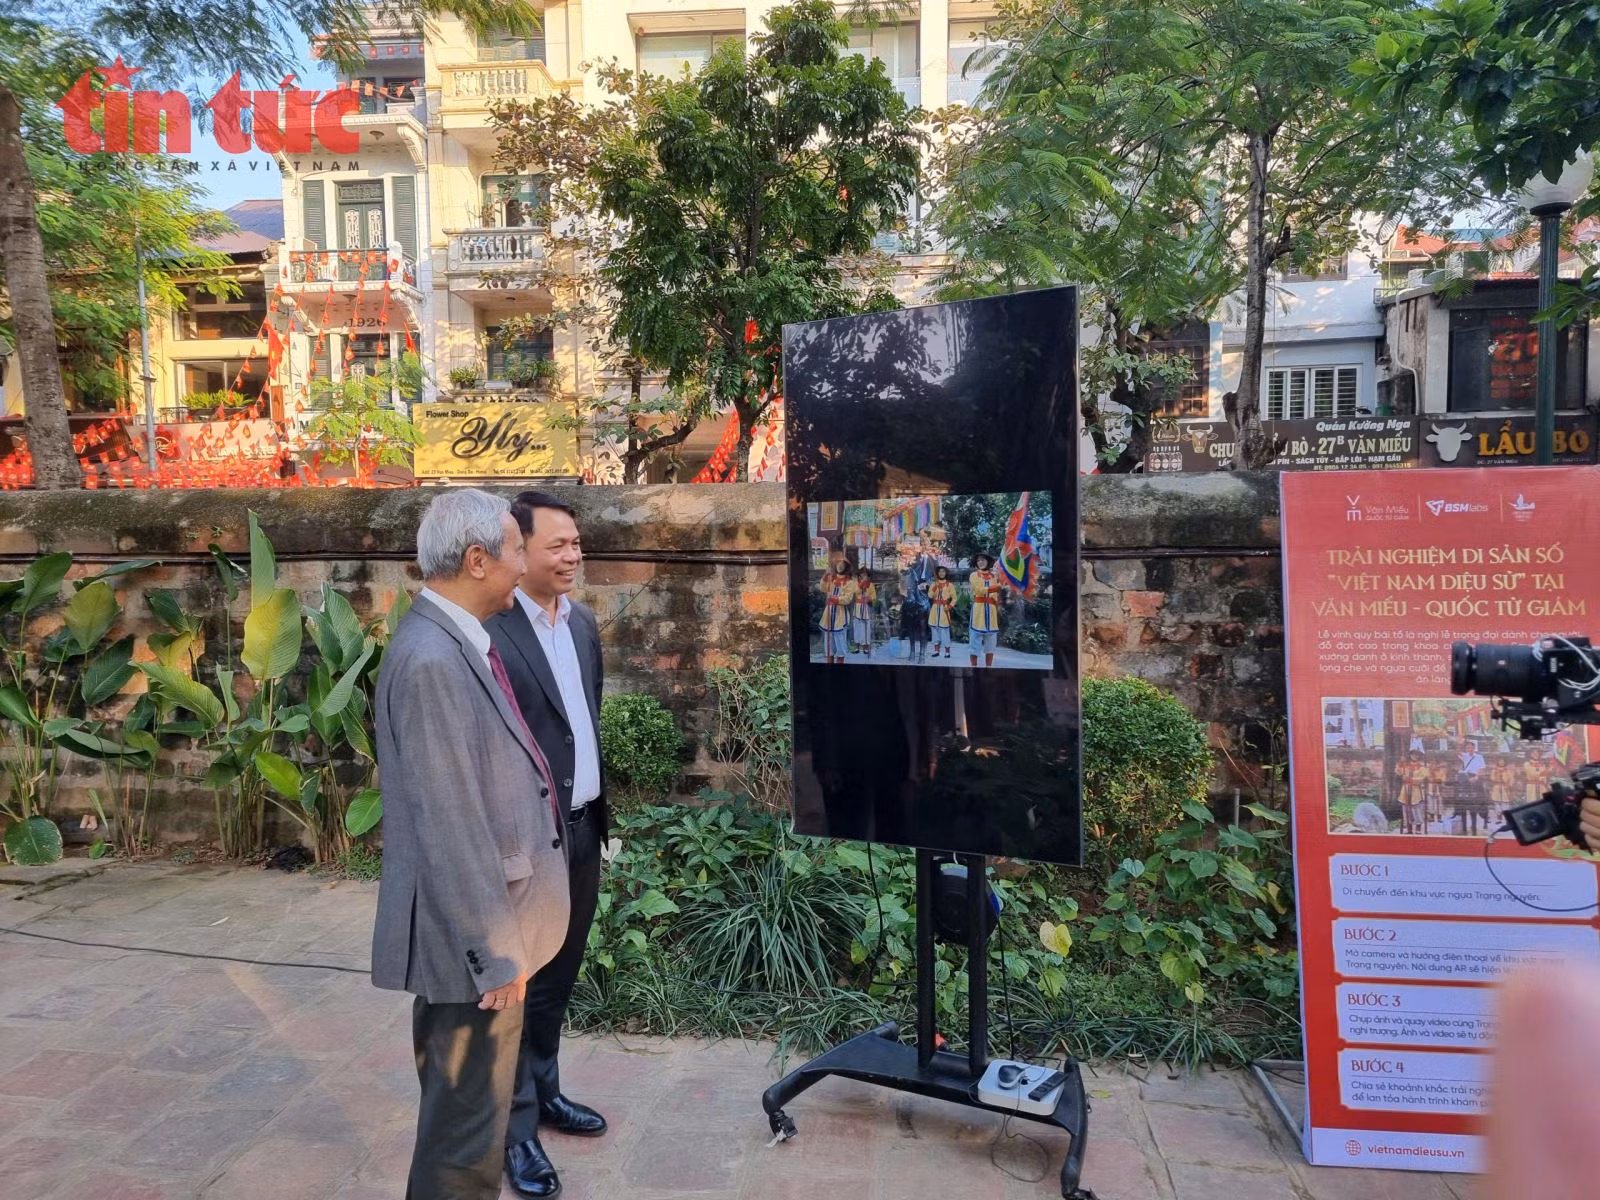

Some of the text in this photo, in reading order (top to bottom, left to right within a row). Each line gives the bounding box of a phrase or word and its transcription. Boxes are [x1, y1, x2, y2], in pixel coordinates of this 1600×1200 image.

[425, 410, 469, 418] Flower Shop
[1387, 419, 1411, 431] Nga
[1291, 436, 1309, 456] BÒ
[1347, 434, 1376, 454] VĂN
[1379, 431, 1412, 453] MIẾU
[1477, 419, 1590, 456] LẨU BÒ
[1326, 541, 1565, 567] TRẢI NGHIỆM DI SẢN SỐ
[1386, 574, 1435, 591] NAM
[1441, 571, 1487, 593] DIỆU
[1531, 573, 1566, 592] TẠI
[1311, 596, 1353, 617] VĂN
[1359, 594, 1408, 617] MIẾU
[1425, 594, 1489, 619] QUỐC
[1494, 595, 1523, 617] TỬ
[1526, 595, 1587, 617] GIÁM
[1331, 630, 1352, 639] vinh
[1353, 631, 1372, 640] quy
[1418, 630, 1439, 640] nghi
[1453, 631, 1480, 640] trọng
[1482, 630, 1499, 640] đại
[1382, 642, 1410, 652] trong
[1414, 642, 1439, 650] khoa
[1352, 652, 1378, 660] danh
[1390, 652, 1410, 660] kinh
[1344, 664, 1362, 672] che
[1340, 863, 1389, 877] BƯỚC 1
[1354, 887, 1388, 898] chuyển
[1390, 888, 1408, 896] đến
[1410, 889, 1427, 898] khu
[1475, 891, 1502, 902] Trạng
[1344, 926, 1397, 942] BƯỚC 2
[1346, 960, 1372, 970] Trạng
[1428, 963, 1452, 973] dung
[1454, 964, 1467, 972] AR
[1347, 992, 1401, 1007] BƯỚC 3
[1348, 1014, 1372, 1024] Chụp
[1404, 1018, 1426, 1027] quay
[1427, 1018, 1451, 1026] video
[1452, 1019, 1474, 1030] cùng
[1350, 1026, 1368, 1036] nghi
[1431, 1030, 1456, 1038] video
[1351, 1058, 1404, 1073] BƯỚC 4
[1352, 1080, 1373, 1090] Chia
[1352, 1092, 1364, 1101] để
[1366, 1093, 1382, 1102] lan
[1402, 1095, 1426, 1104] hành
[1367, 1144, 1464, 1158] vietnamdieusu.vn
